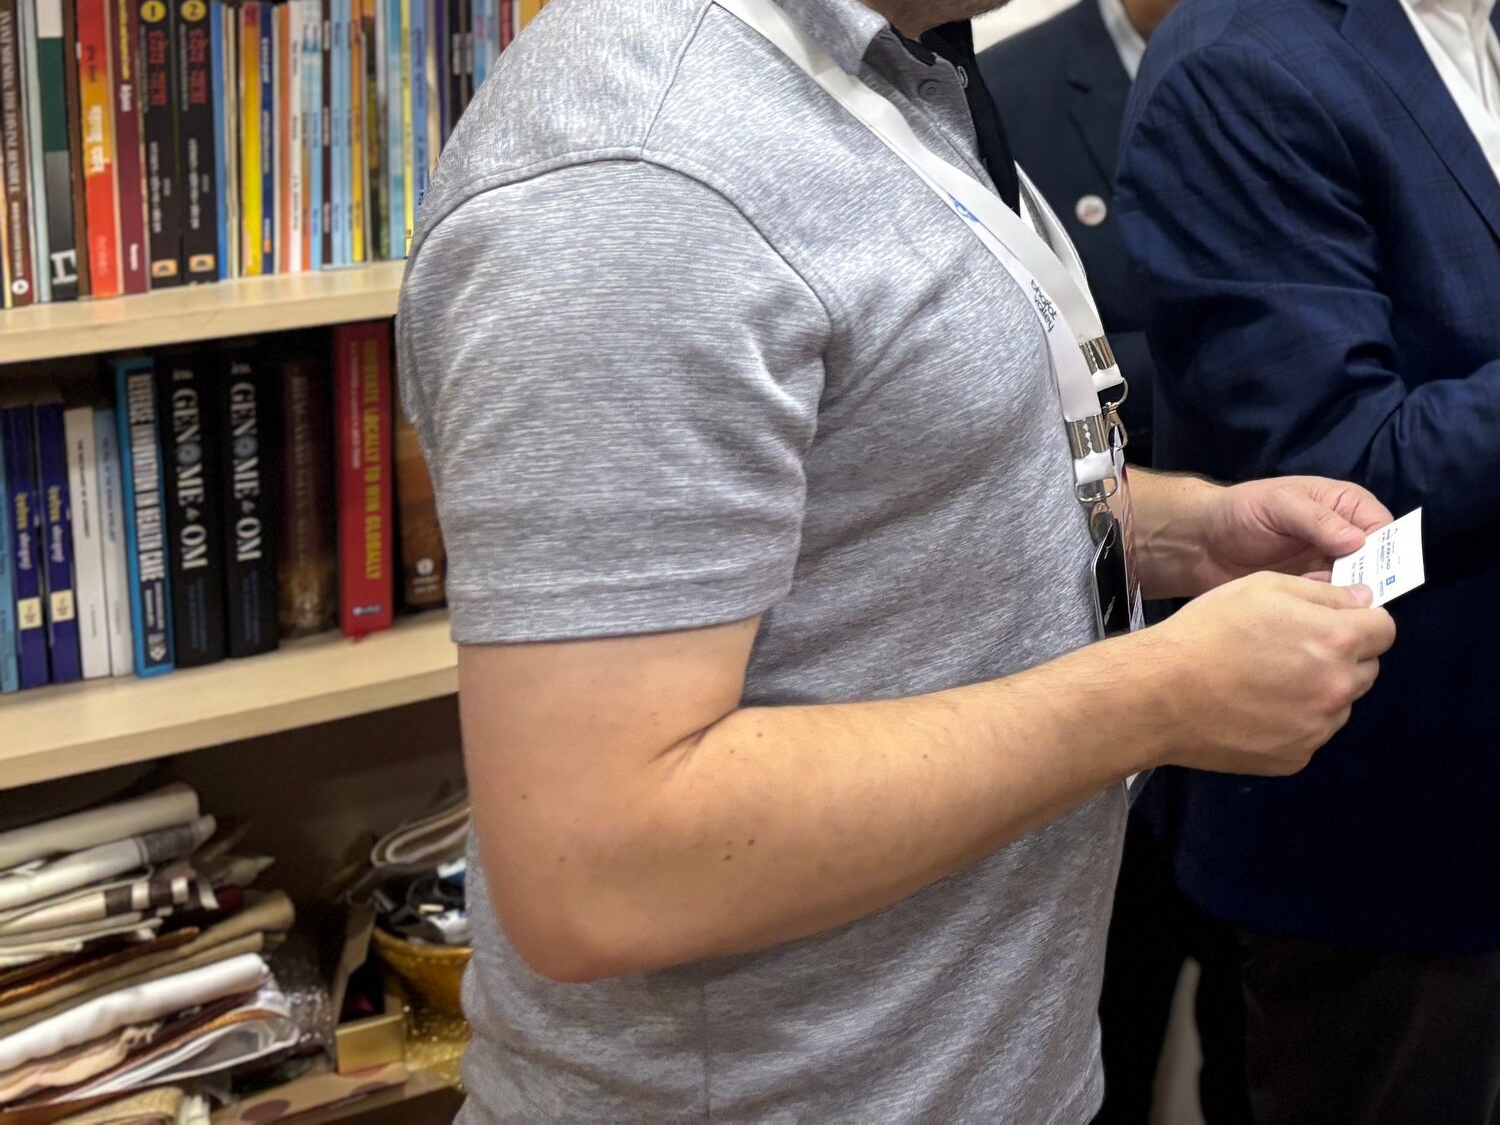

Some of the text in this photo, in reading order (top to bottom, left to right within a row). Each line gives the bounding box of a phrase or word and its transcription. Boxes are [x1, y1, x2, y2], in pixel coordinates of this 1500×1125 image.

[1034, 294, 1056, 333] valley
[127, 373, 155, 424] REVERSE
[363, 407, 383, 463] LOCALLY
[131, 424, 160, 492] INNOVATION
[364, 465, 383, 482] TO
[135, 492, 161, 508] IN
[364, 484, 383, 513] WIN
[136, 508, 164, 551] HEALTH
[180, 524, 208, 571] OM
[236, 517, 262, 562] OM
[364, 515, 384, 581] GLOBALLY
[139, 551, 165, 583] CARE
